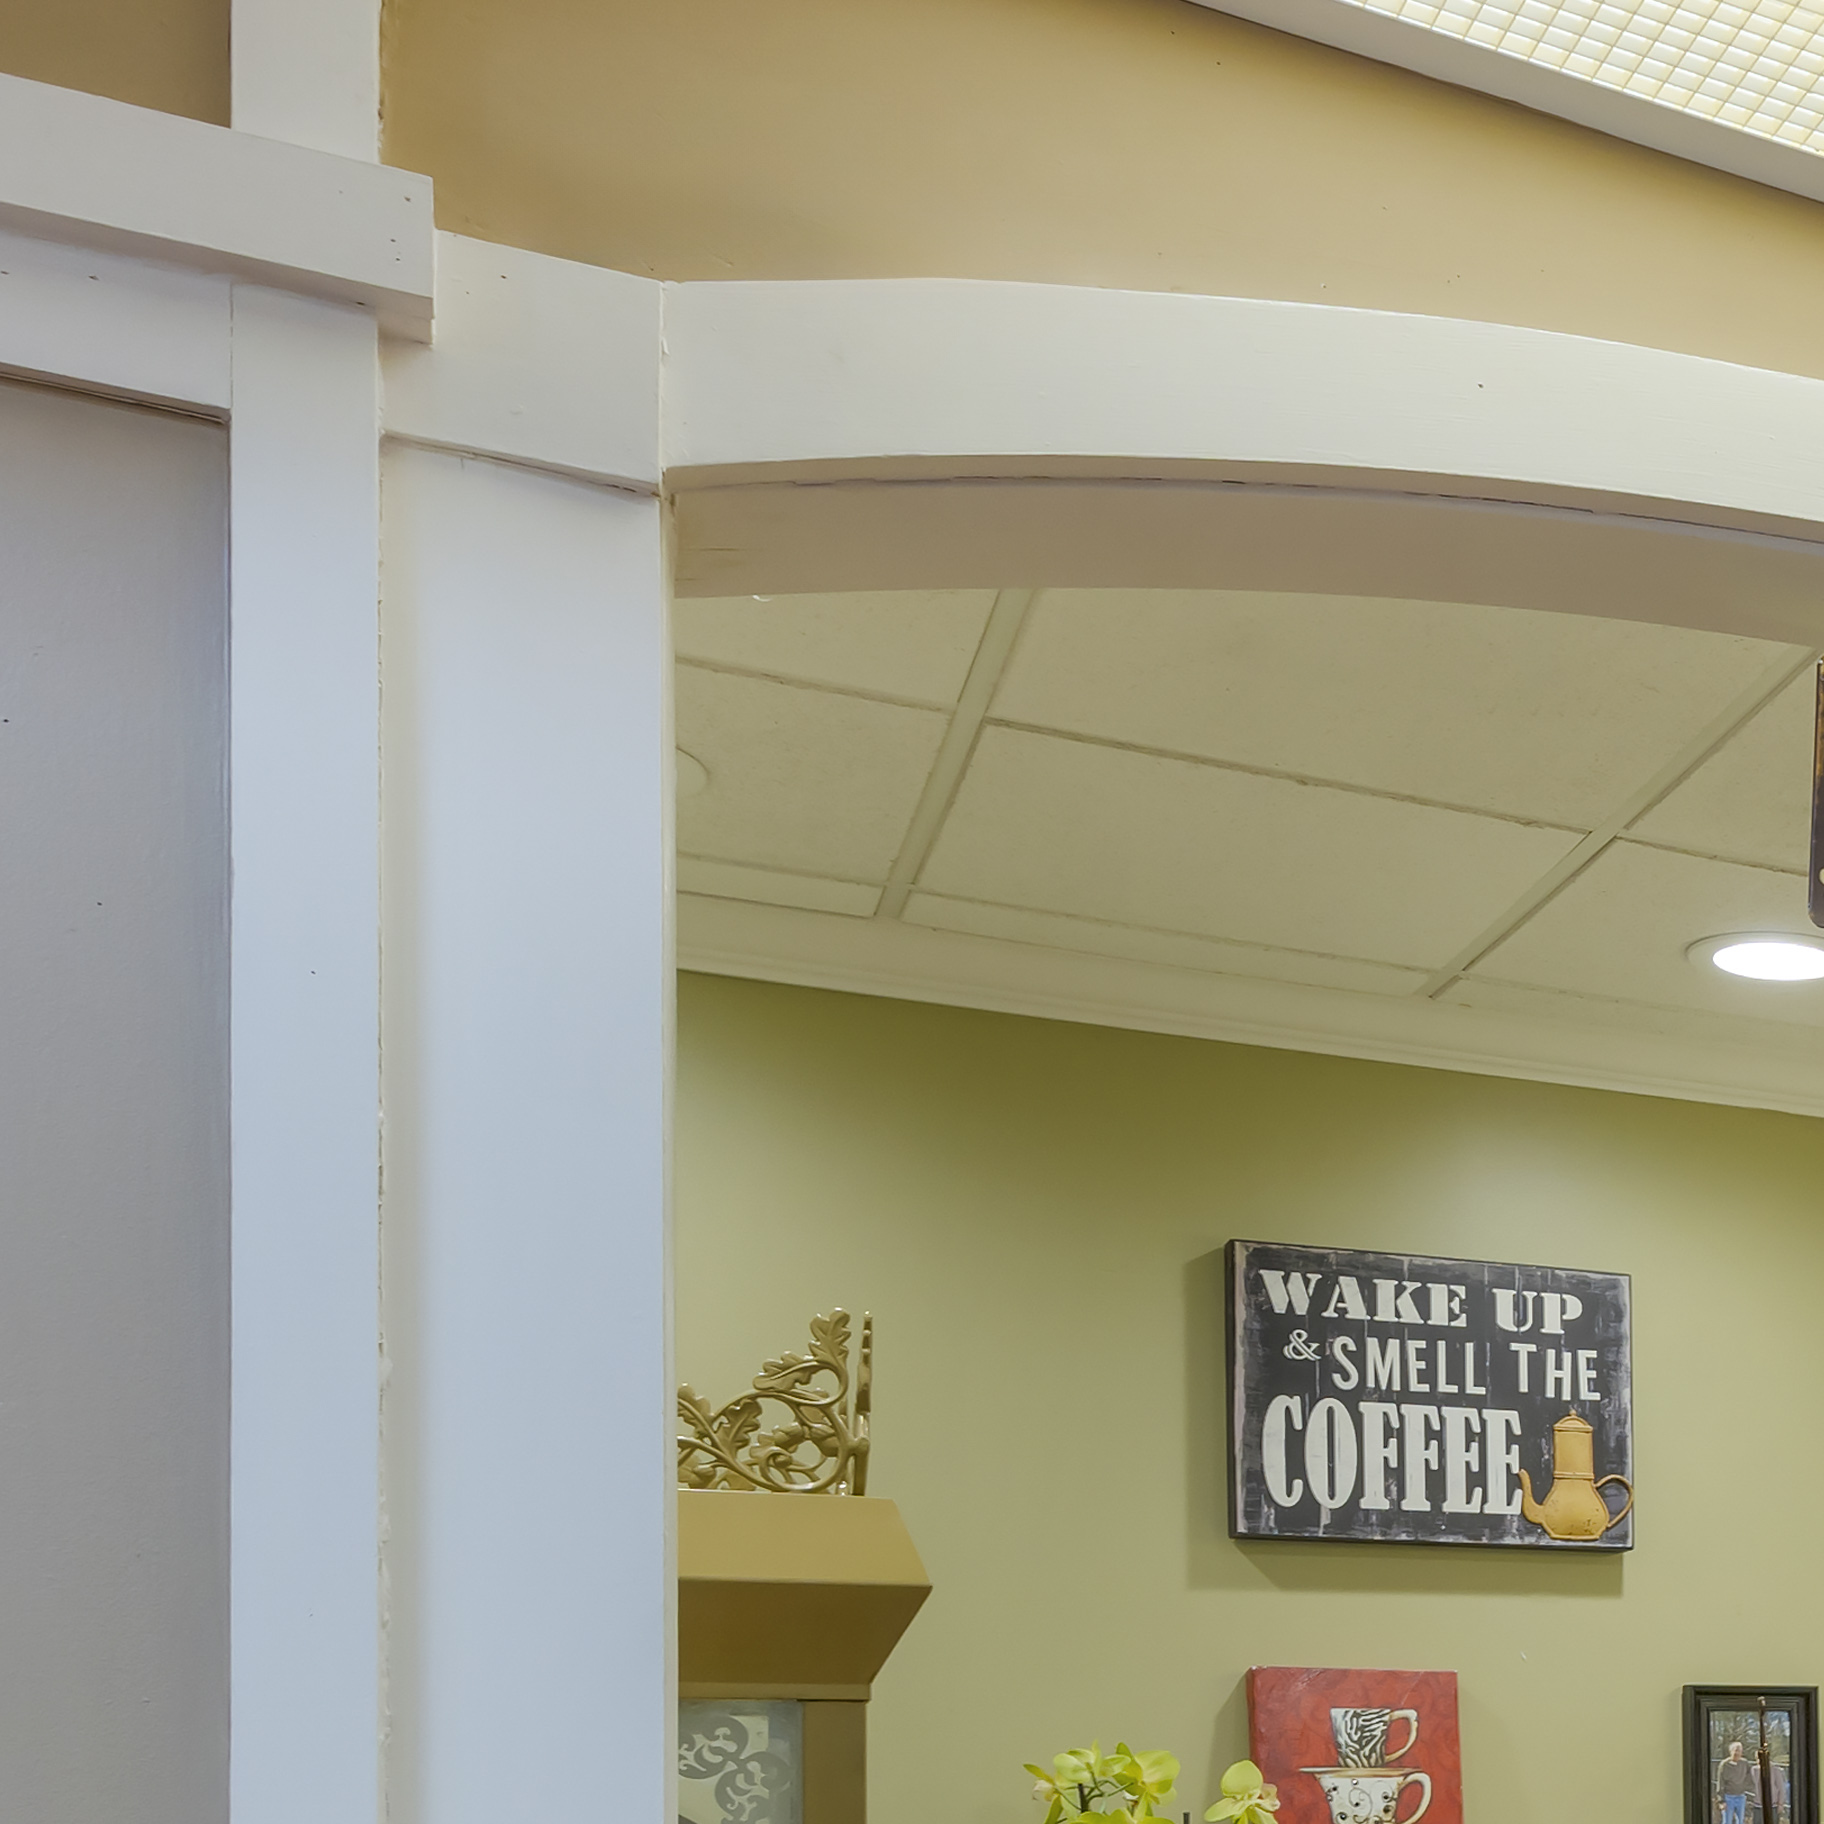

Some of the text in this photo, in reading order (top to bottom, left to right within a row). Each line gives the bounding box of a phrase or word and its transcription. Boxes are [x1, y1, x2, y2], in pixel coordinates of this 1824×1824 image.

[1258, 1269, 1583, 1334] WAKE UP
[1283, 1329, 1600, 1400] & SMELL THE
[1262, 1394, 1522, 1515] COFFEE
